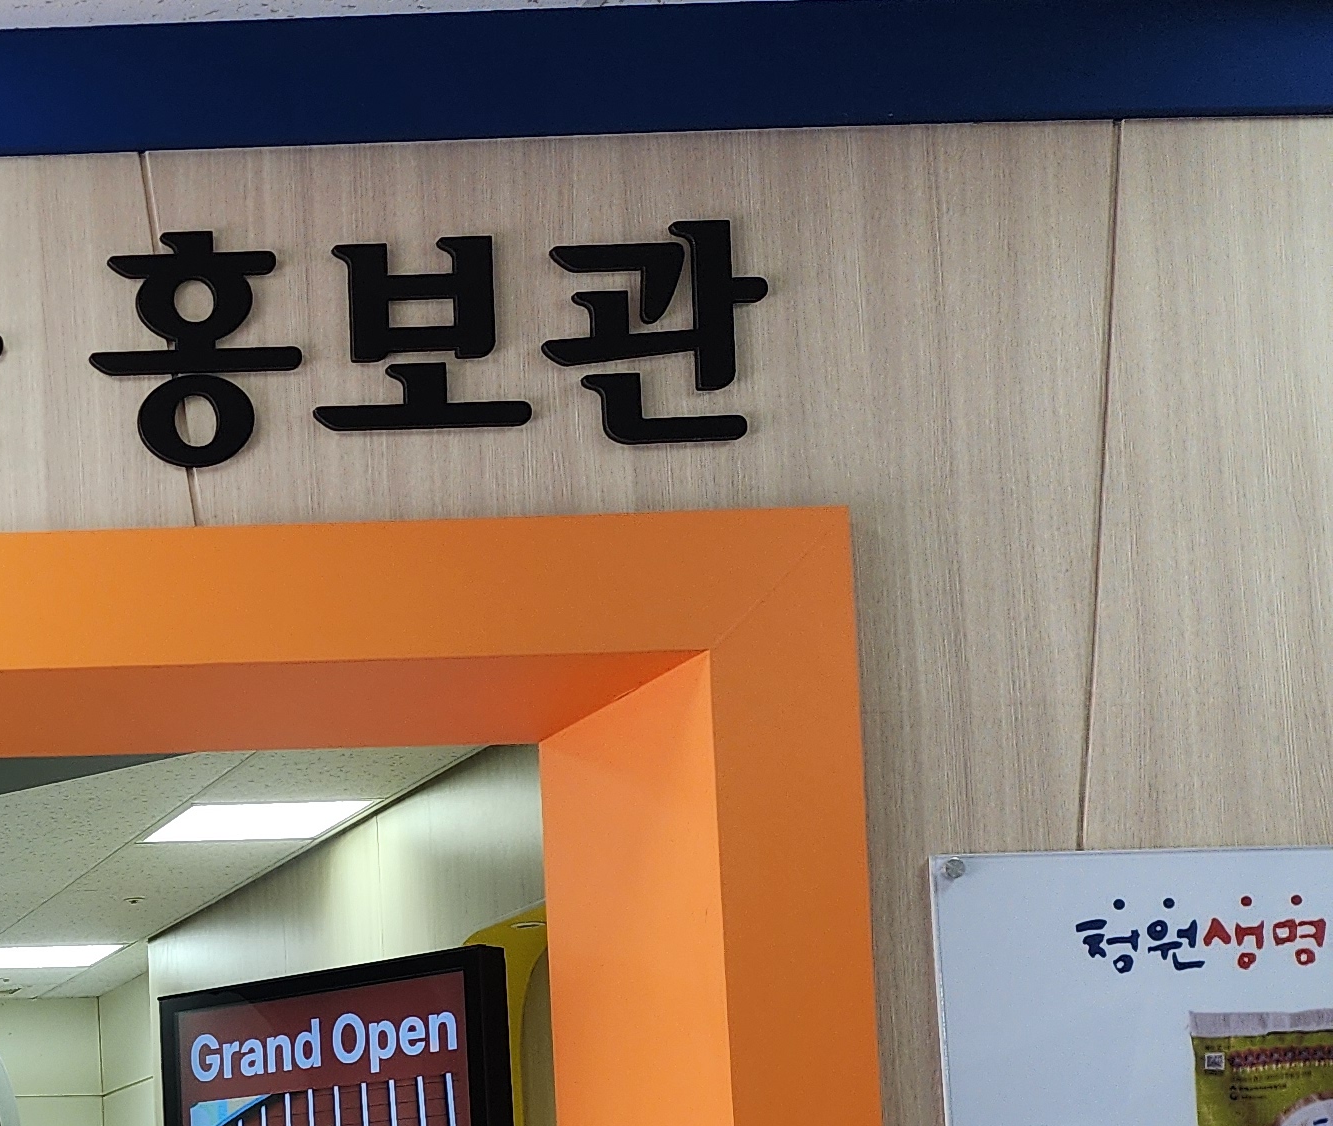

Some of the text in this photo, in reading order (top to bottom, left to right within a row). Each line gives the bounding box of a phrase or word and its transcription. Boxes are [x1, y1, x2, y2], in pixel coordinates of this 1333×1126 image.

[88, 219, 769, 469] 홍보관
[1075, 915, 1326, 974] 청원생명
[190, 1010, 458, 1083] Grand Open
